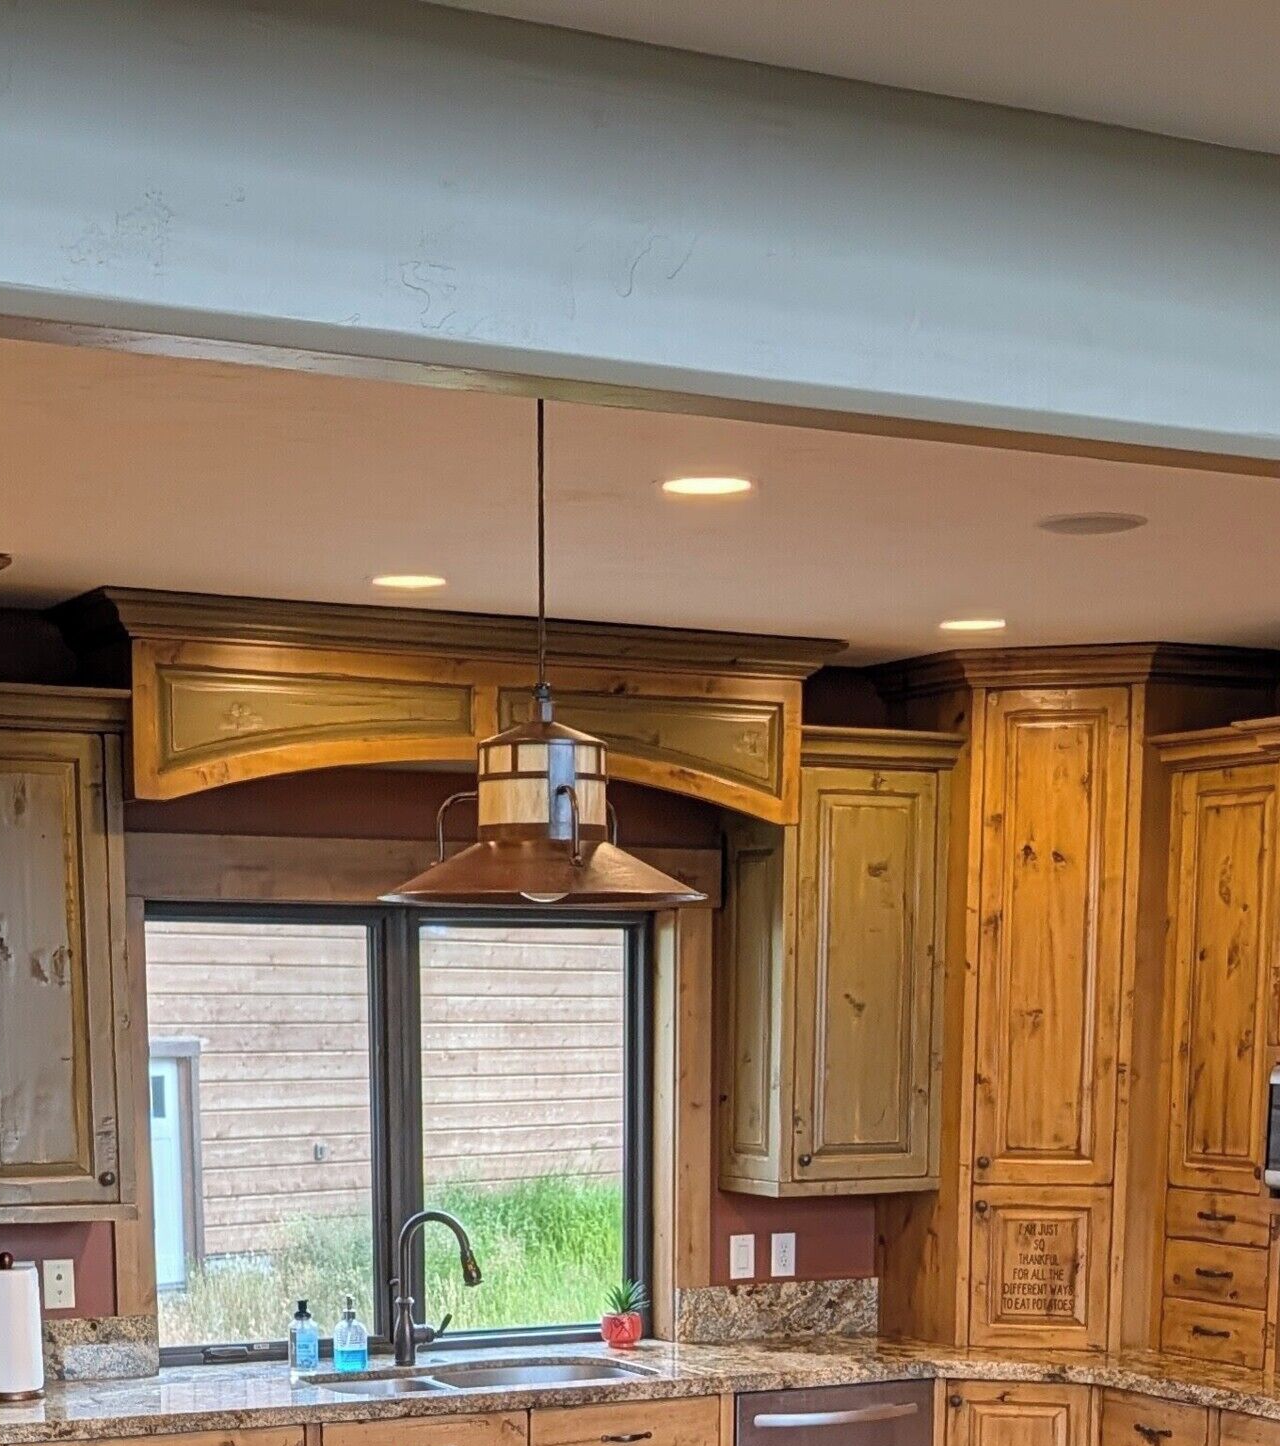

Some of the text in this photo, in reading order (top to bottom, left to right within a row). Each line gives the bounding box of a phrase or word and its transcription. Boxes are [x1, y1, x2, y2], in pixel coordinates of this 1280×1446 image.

[1038, 1224, 1058, 1235] JUST
[1019, 1254, 1059, 1265] THANKFUL
[1013, 1268, 1064, 1280] FOR ALL THE
[1002, 1283, 1074, 1296] DIFFERENT WAYS
[1002, 1297, 1073, 1311] TO EAT POTATOES
